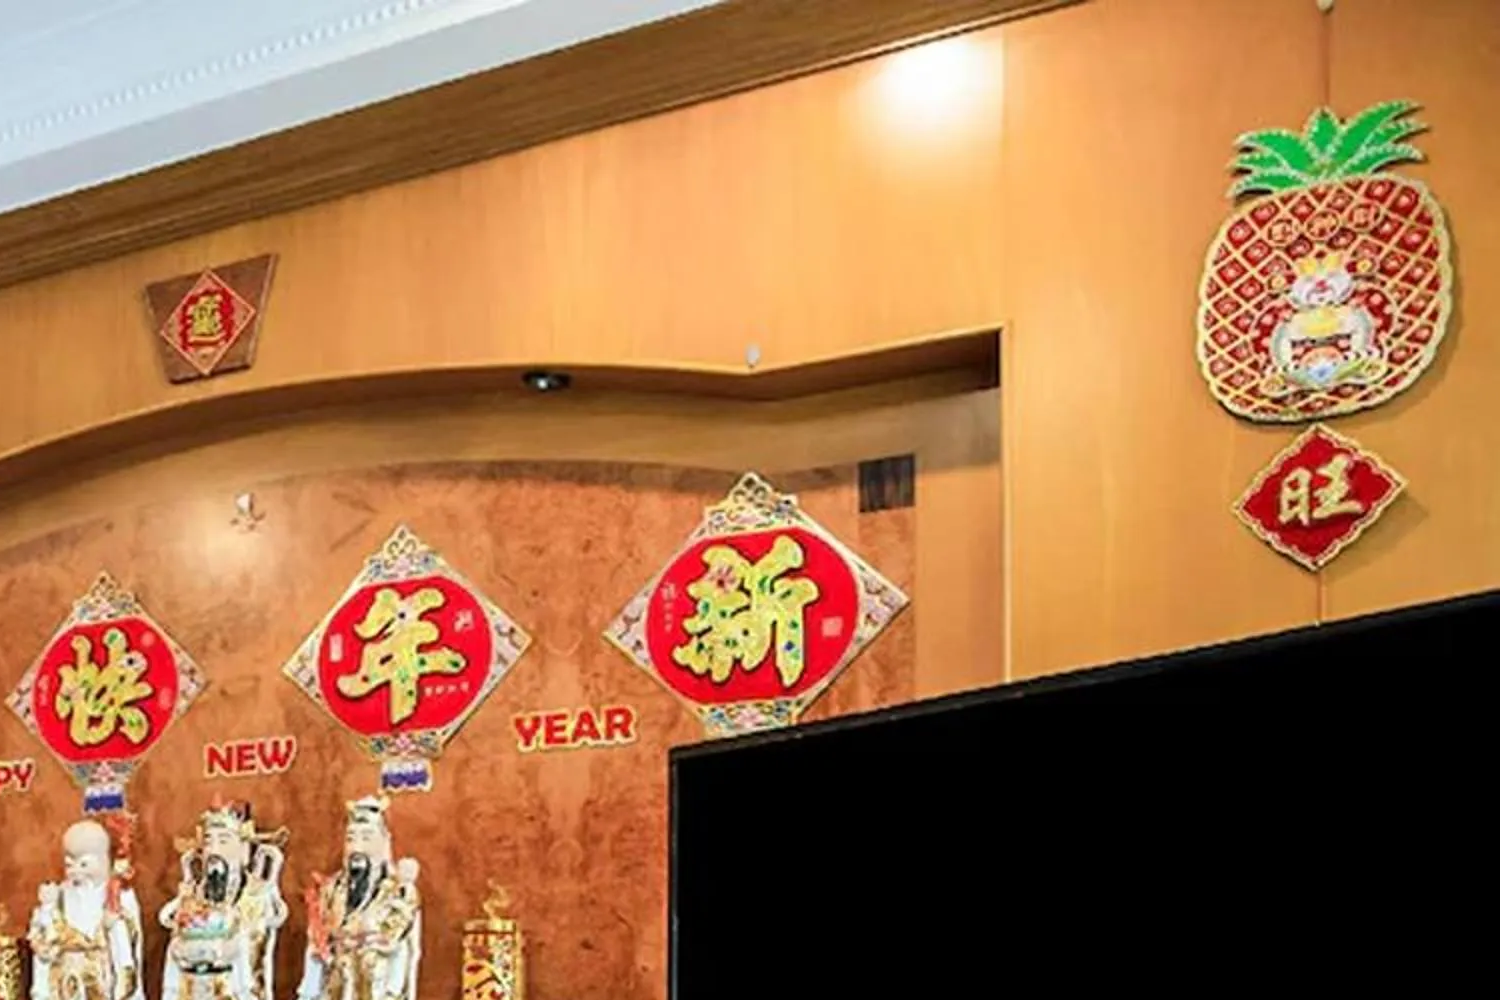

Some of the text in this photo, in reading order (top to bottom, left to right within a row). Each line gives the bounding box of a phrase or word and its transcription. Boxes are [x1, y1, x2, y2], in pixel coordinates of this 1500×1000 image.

[1279, 454, 1364, 526] 旺
[336, 587, 467, 726] 年
[671, 535, 820, 688] 新
[54, 627, 154, 747] 快
[206, 738, 294, 776] NEW
[513, 706, 636, 749] YEAR
